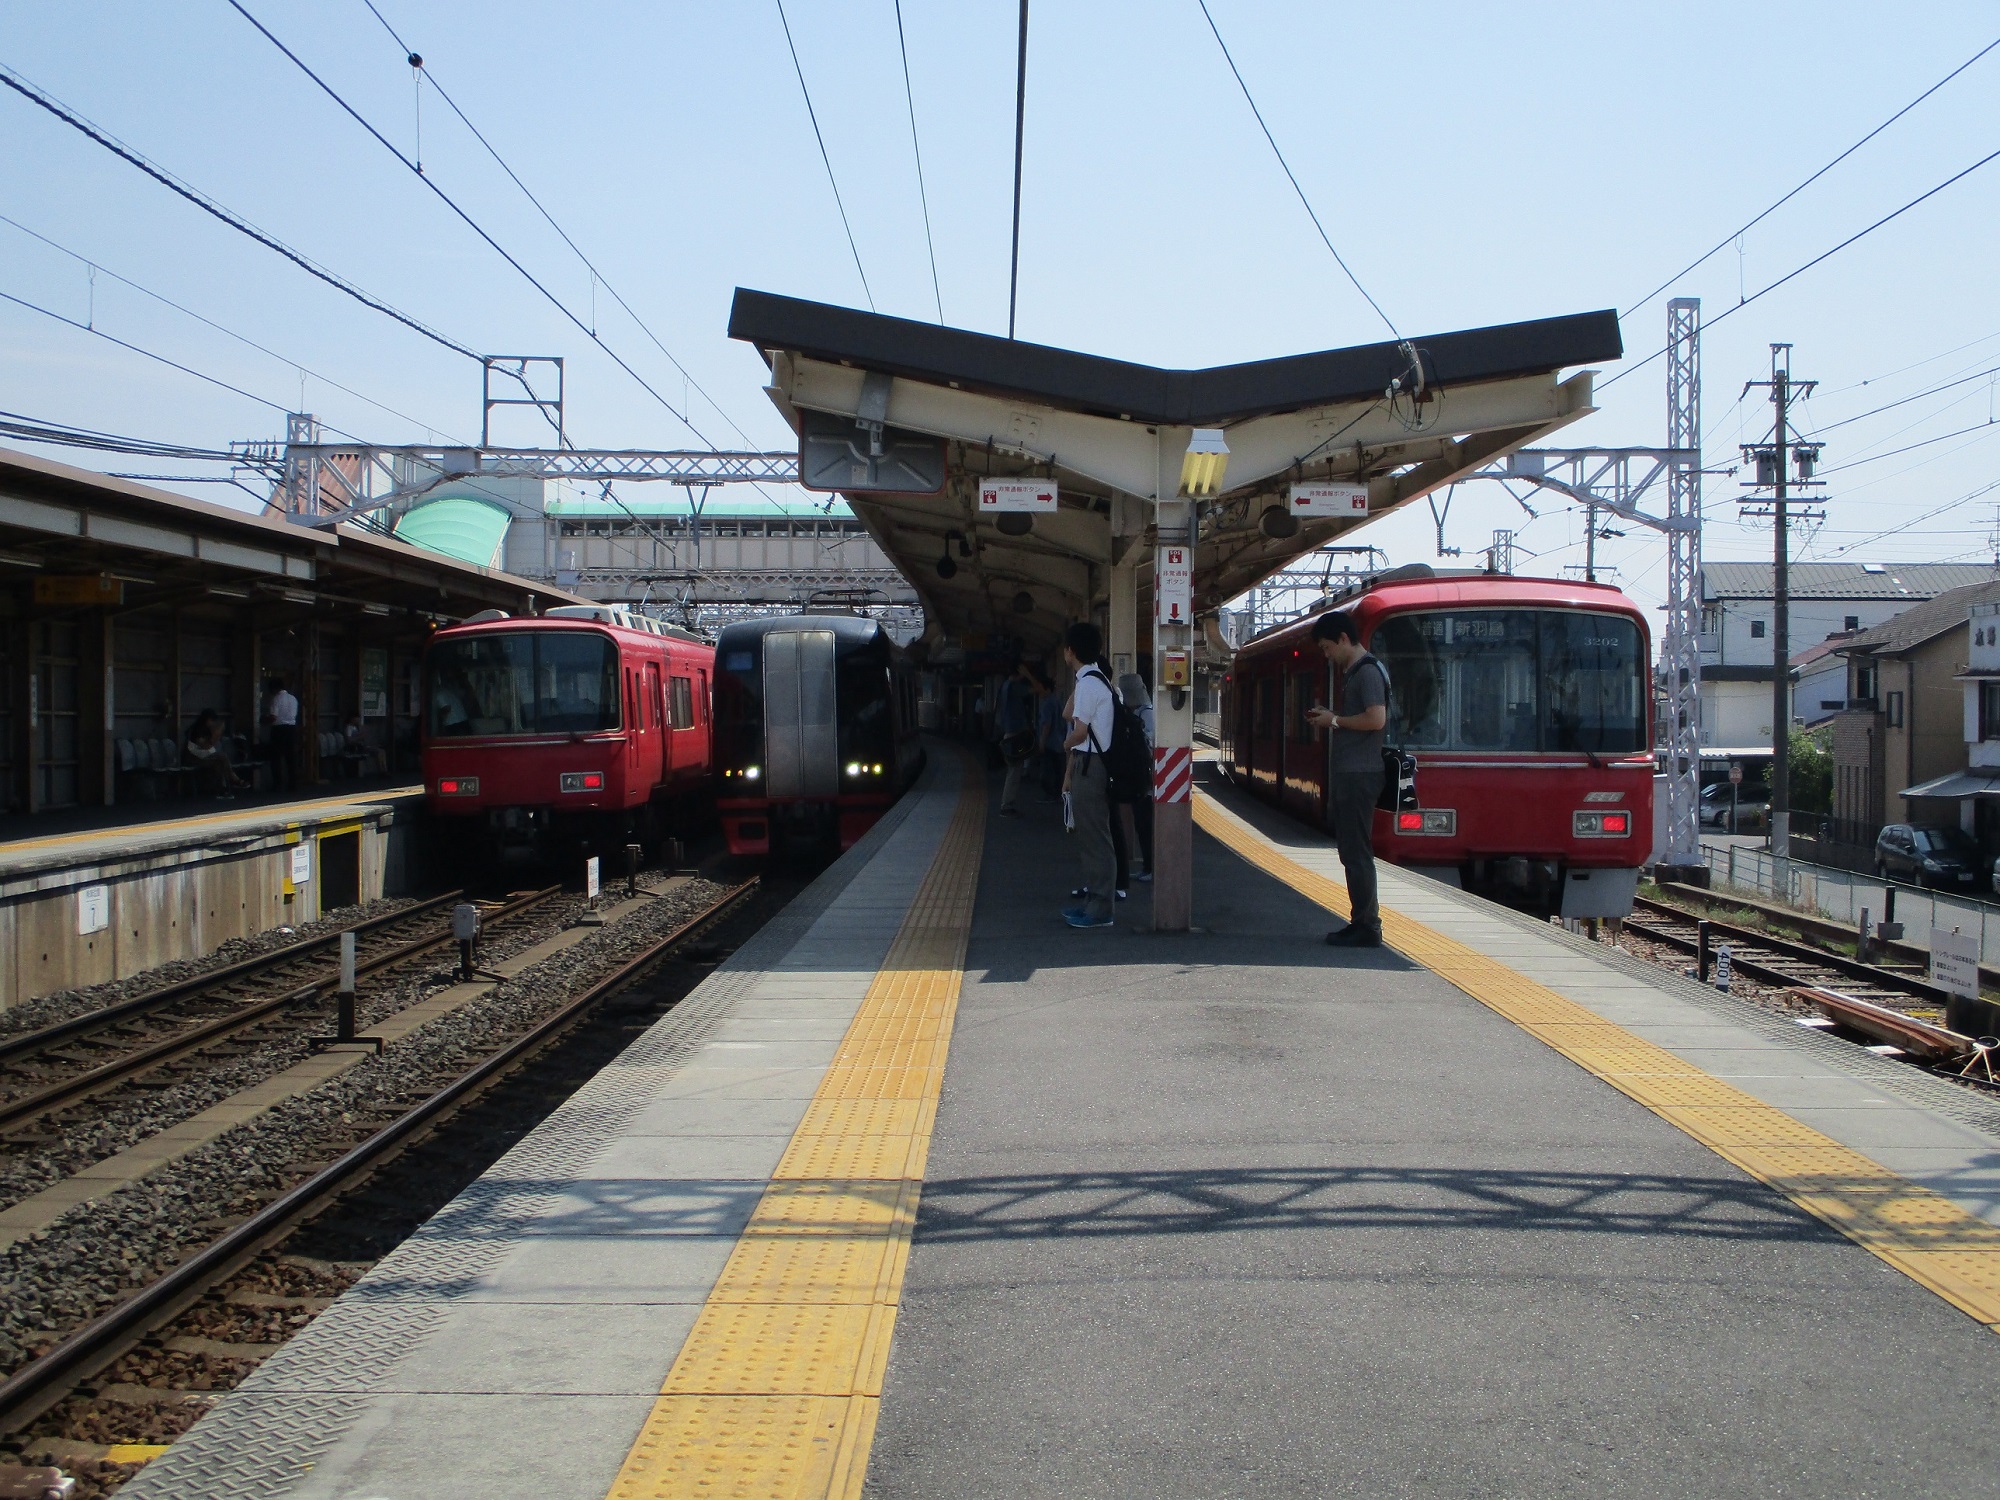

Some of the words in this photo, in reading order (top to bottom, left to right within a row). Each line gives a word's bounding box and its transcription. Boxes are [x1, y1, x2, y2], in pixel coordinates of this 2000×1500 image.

[1421, 620, 1445, 636] 普通
[1454, 620, 1504, 636] 新羽島
[1583, 636, 1619, 647] 3202
[1718, 952, 1729, 978] 400
